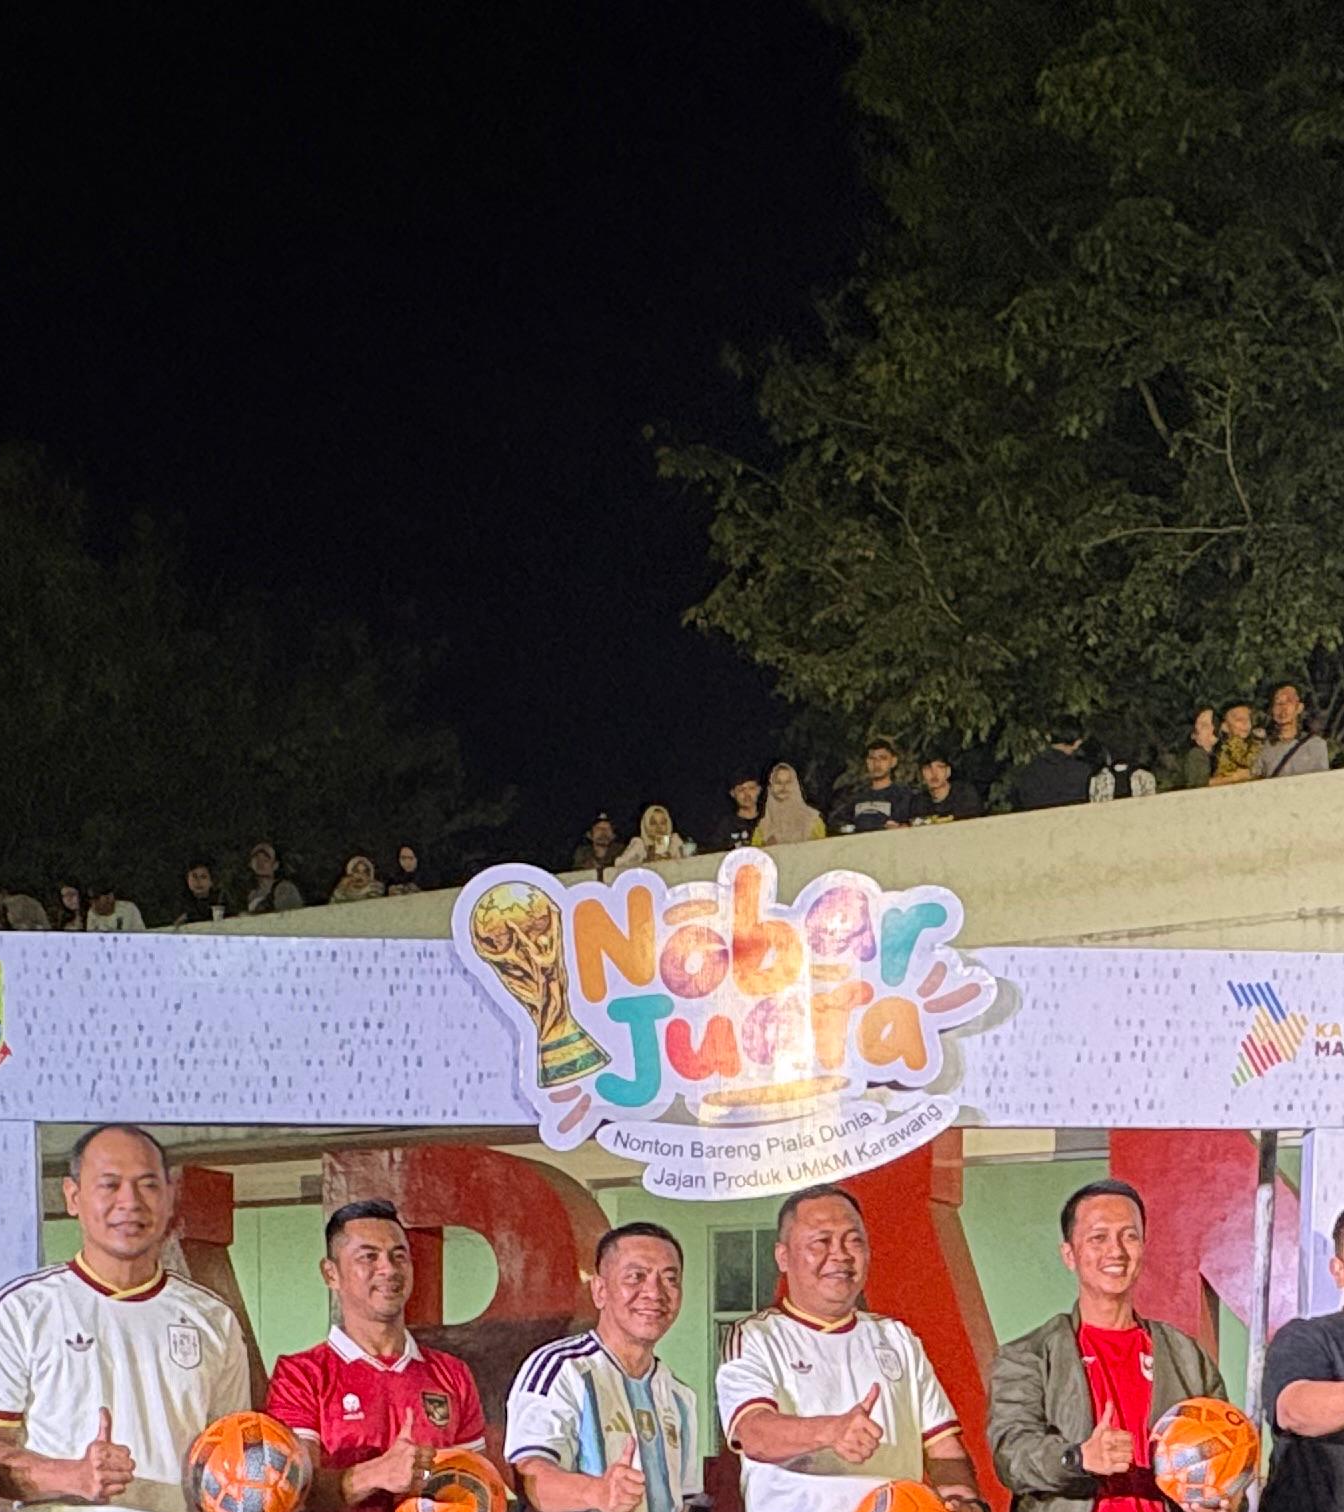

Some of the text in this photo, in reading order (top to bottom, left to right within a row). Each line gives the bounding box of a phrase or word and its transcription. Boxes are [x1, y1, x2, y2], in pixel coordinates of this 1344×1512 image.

[573, 863, 948, 1003] Nobar
[595, 980, 929, 1108] Juara
[613, 1129, 685, 1158] Nonton
[690, 1139, 762, 1162] Bareng
[767, 1133, 816, 1155] Piala
[652, 1102, 944, 1191] Jajan Produk UMKM Karawang
